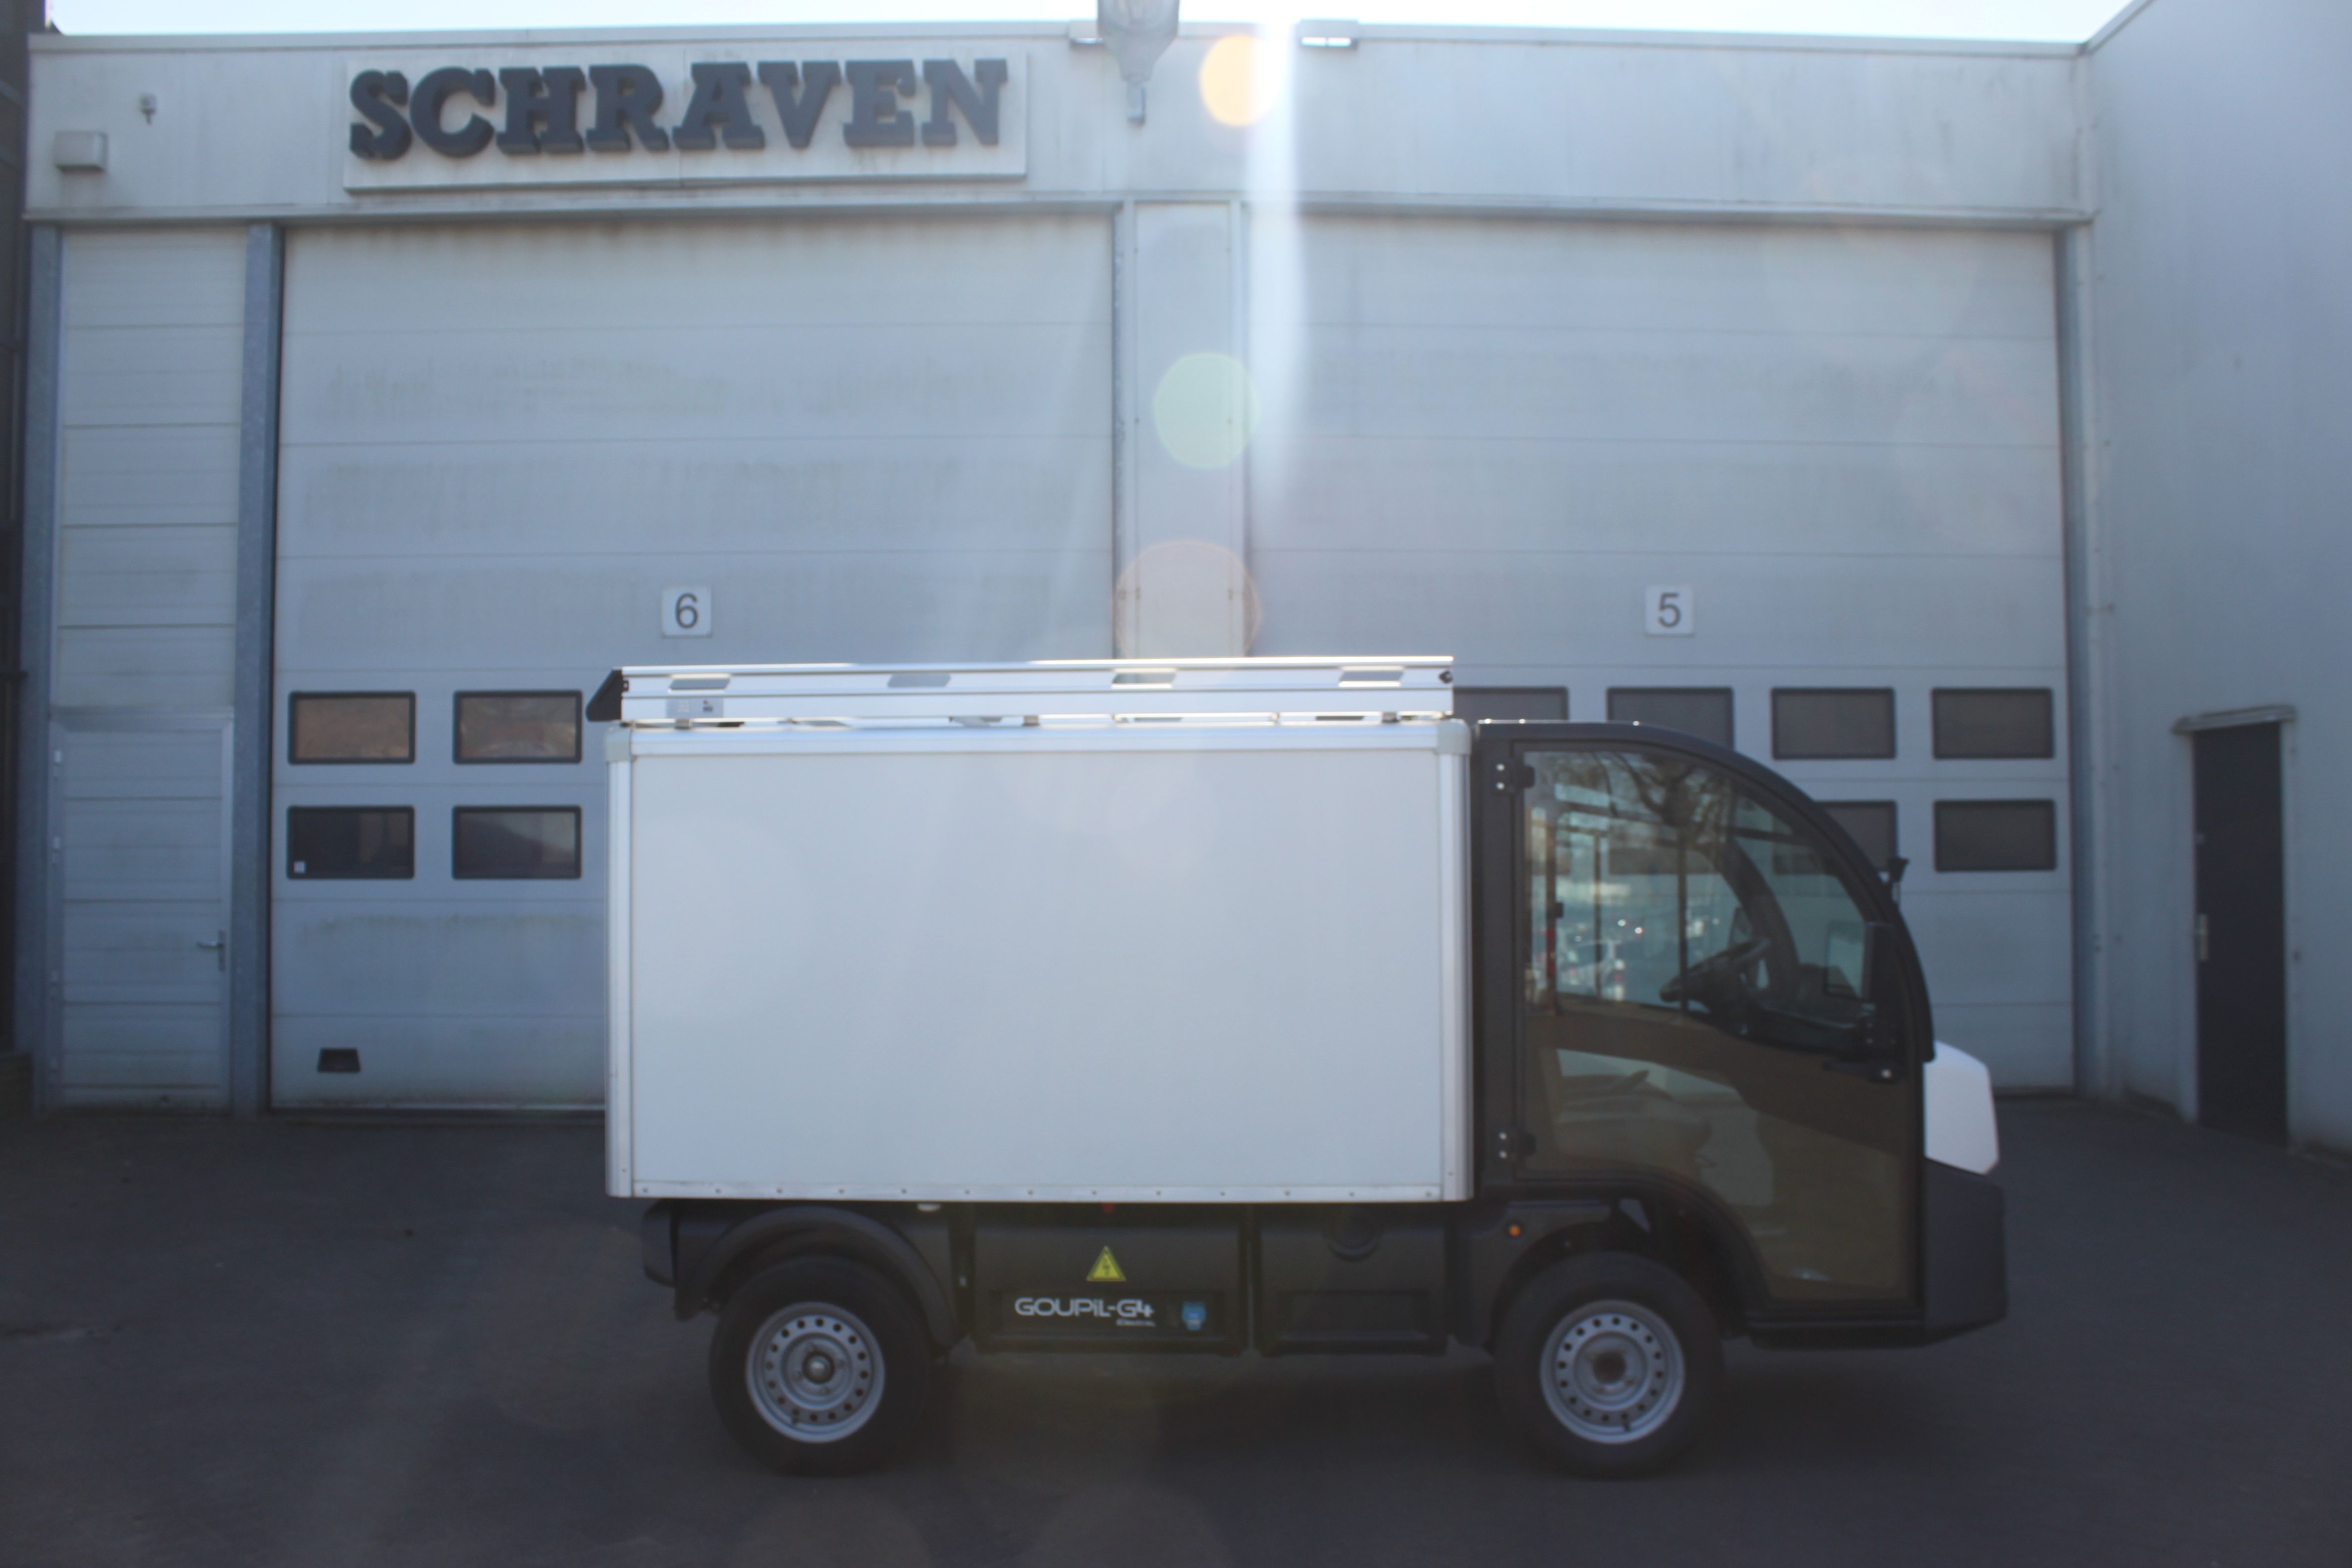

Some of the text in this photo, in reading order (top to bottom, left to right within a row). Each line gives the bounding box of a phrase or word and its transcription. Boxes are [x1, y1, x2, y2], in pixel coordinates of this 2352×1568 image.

[349, 58, 1008, 159] SCHRAVEN
[675, 593, 698, 629] 6
[1659, 592, 1681, 629] 5
